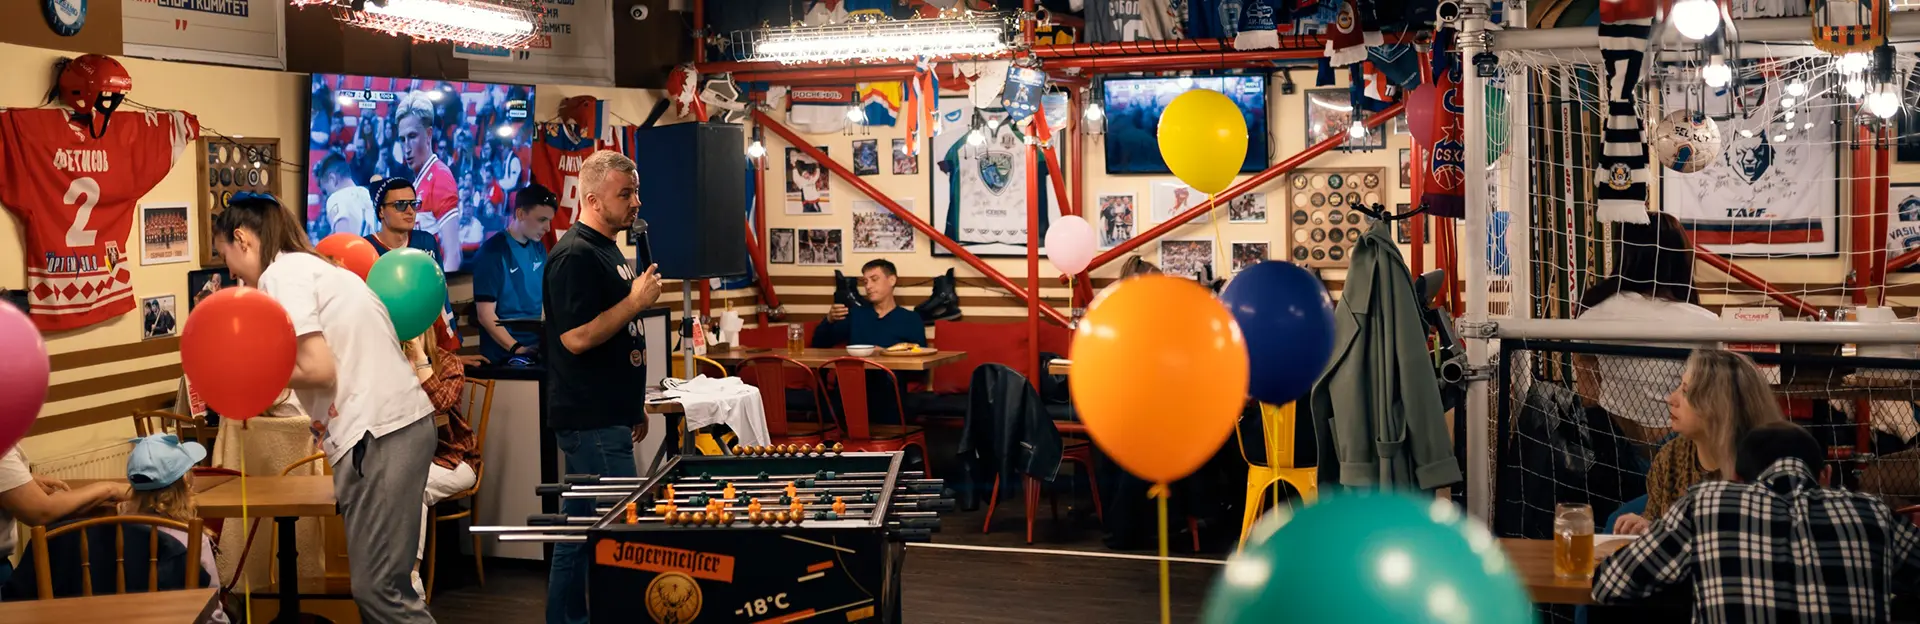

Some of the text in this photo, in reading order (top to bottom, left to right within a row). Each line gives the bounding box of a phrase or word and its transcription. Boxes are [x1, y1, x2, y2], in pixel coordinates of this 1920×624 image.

[53, 148, 109, 172] ФЕТИСОВ
[63, 176, 100, 248] 2
[1889, 225, 1920, 240] VASIL
[735, 592, 790, 618] -18°C
